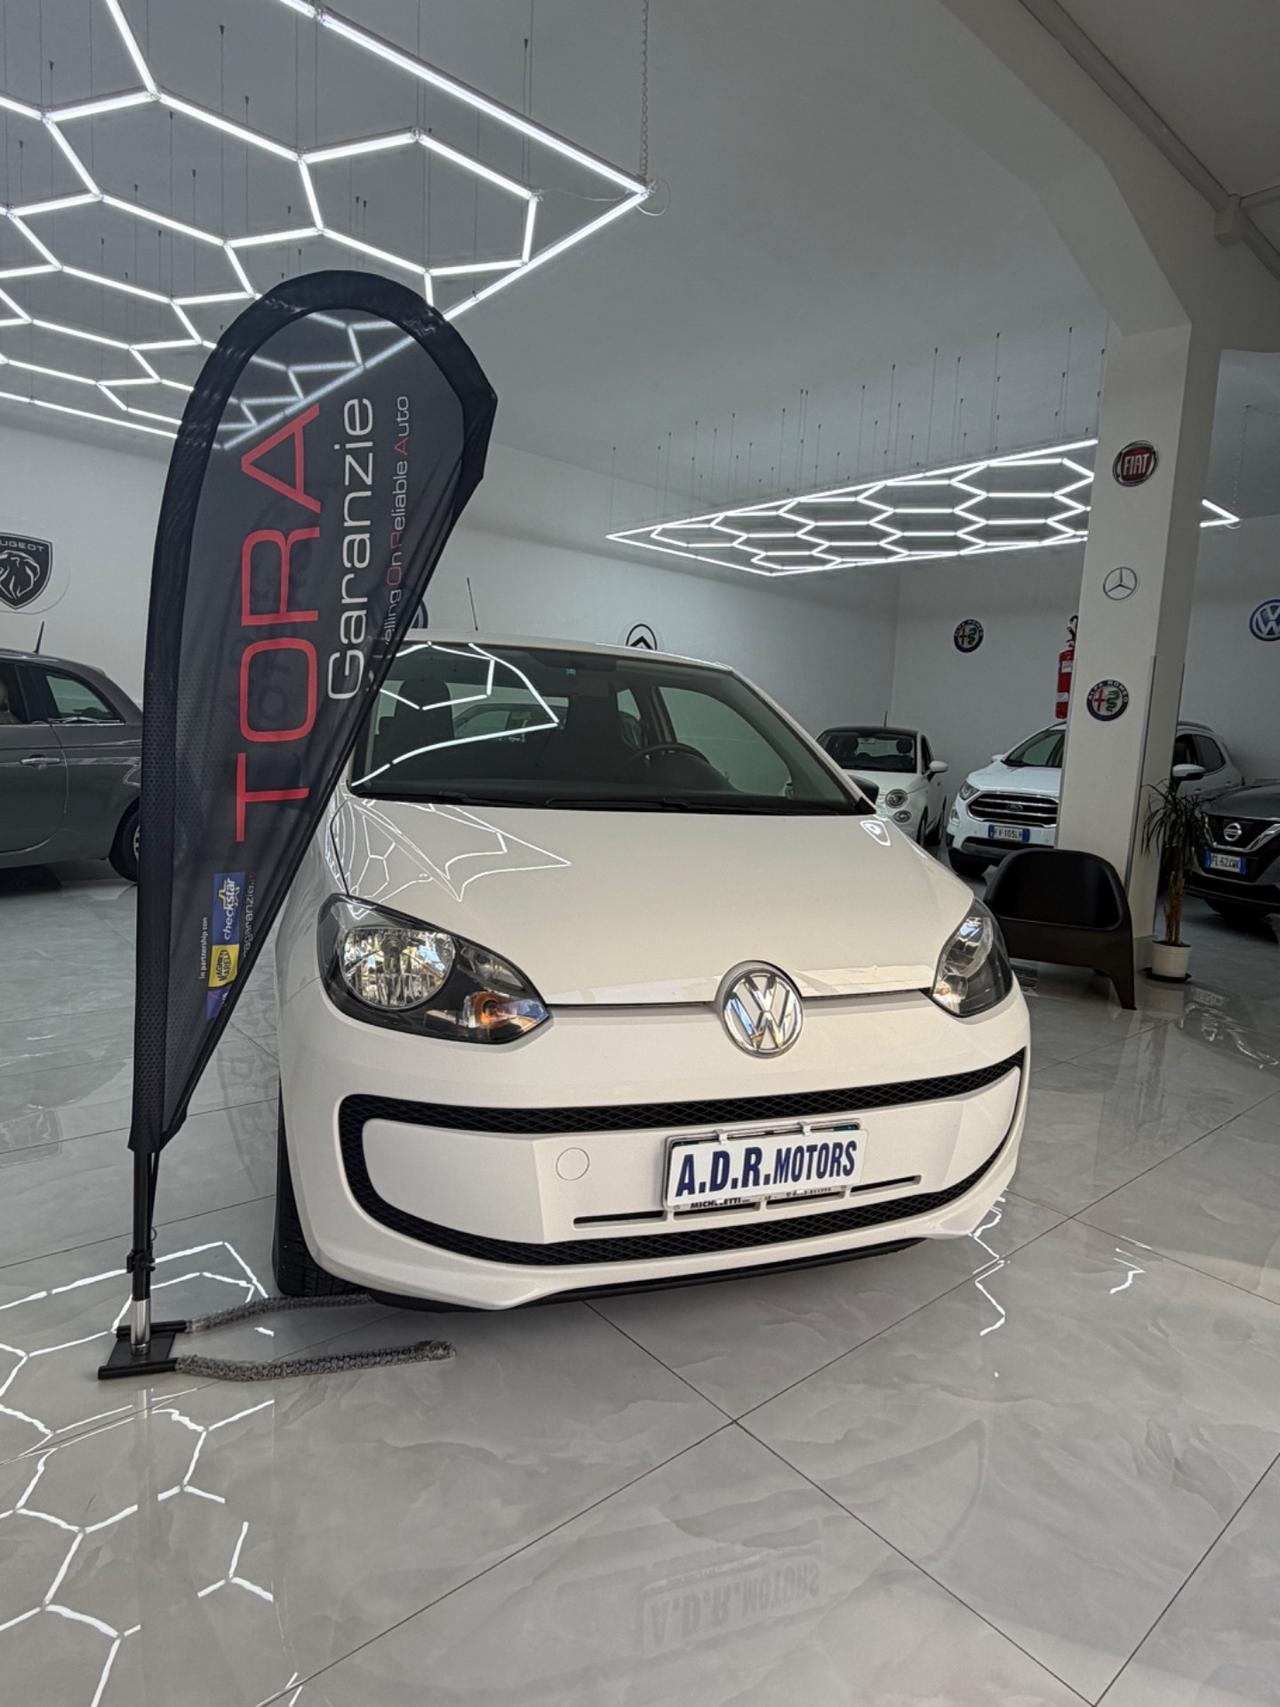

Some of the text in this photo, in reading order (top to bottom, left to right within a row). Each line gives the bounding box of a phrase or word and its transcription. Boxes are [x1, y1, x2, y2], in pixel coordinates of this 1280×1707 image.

[393, 396, 410, 455] Auto
[1123, 454, 1150, 475] FIAT
[390, 460, 408, 549] Reliable
[327, 398, 374, 699] Garanzie
[386, 556, 403, 587] On
[235, 402, 322, 842] TORA
[222, 877, 236, 940] checkstar
